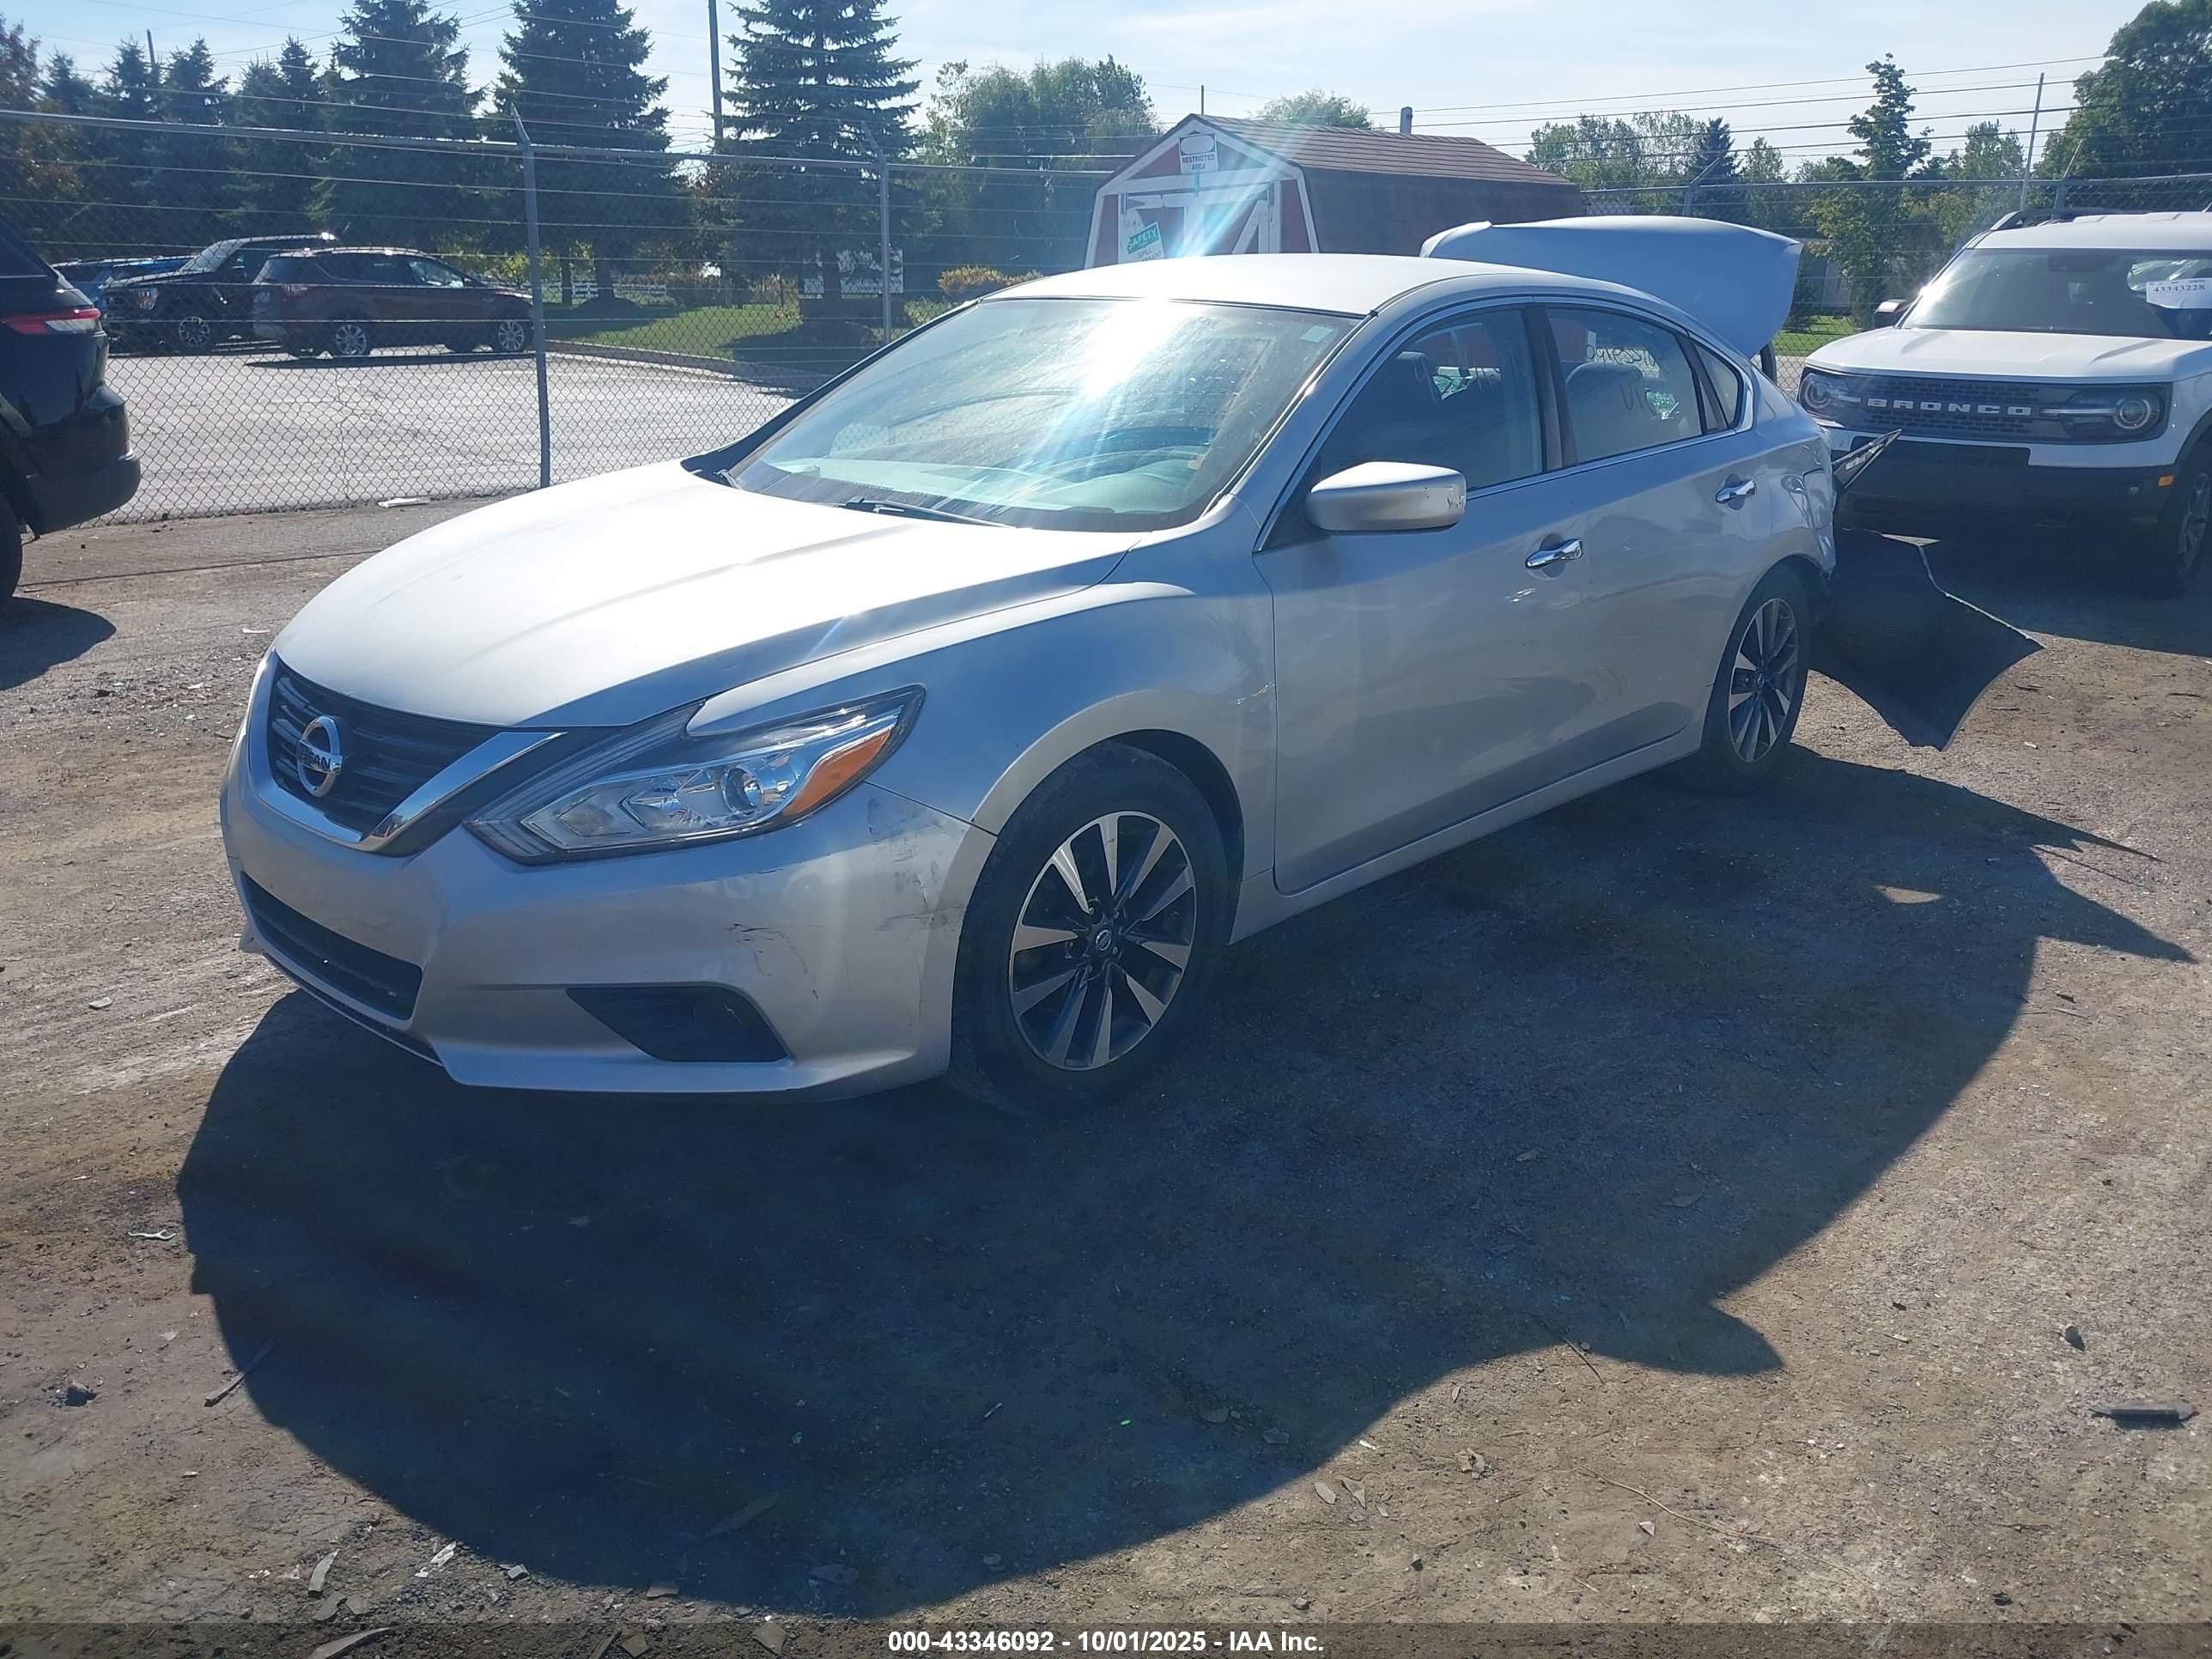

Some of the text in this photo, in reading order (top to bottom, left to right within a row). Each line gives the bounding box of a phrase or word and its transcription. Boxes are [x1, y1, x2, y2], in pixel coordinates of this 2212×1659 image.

[1182, 155, 1215, 164] RESTRICTED
[1127, 226, 1157, 250] SAFETY
[1867, 398, 2032, 416] BRONCO
